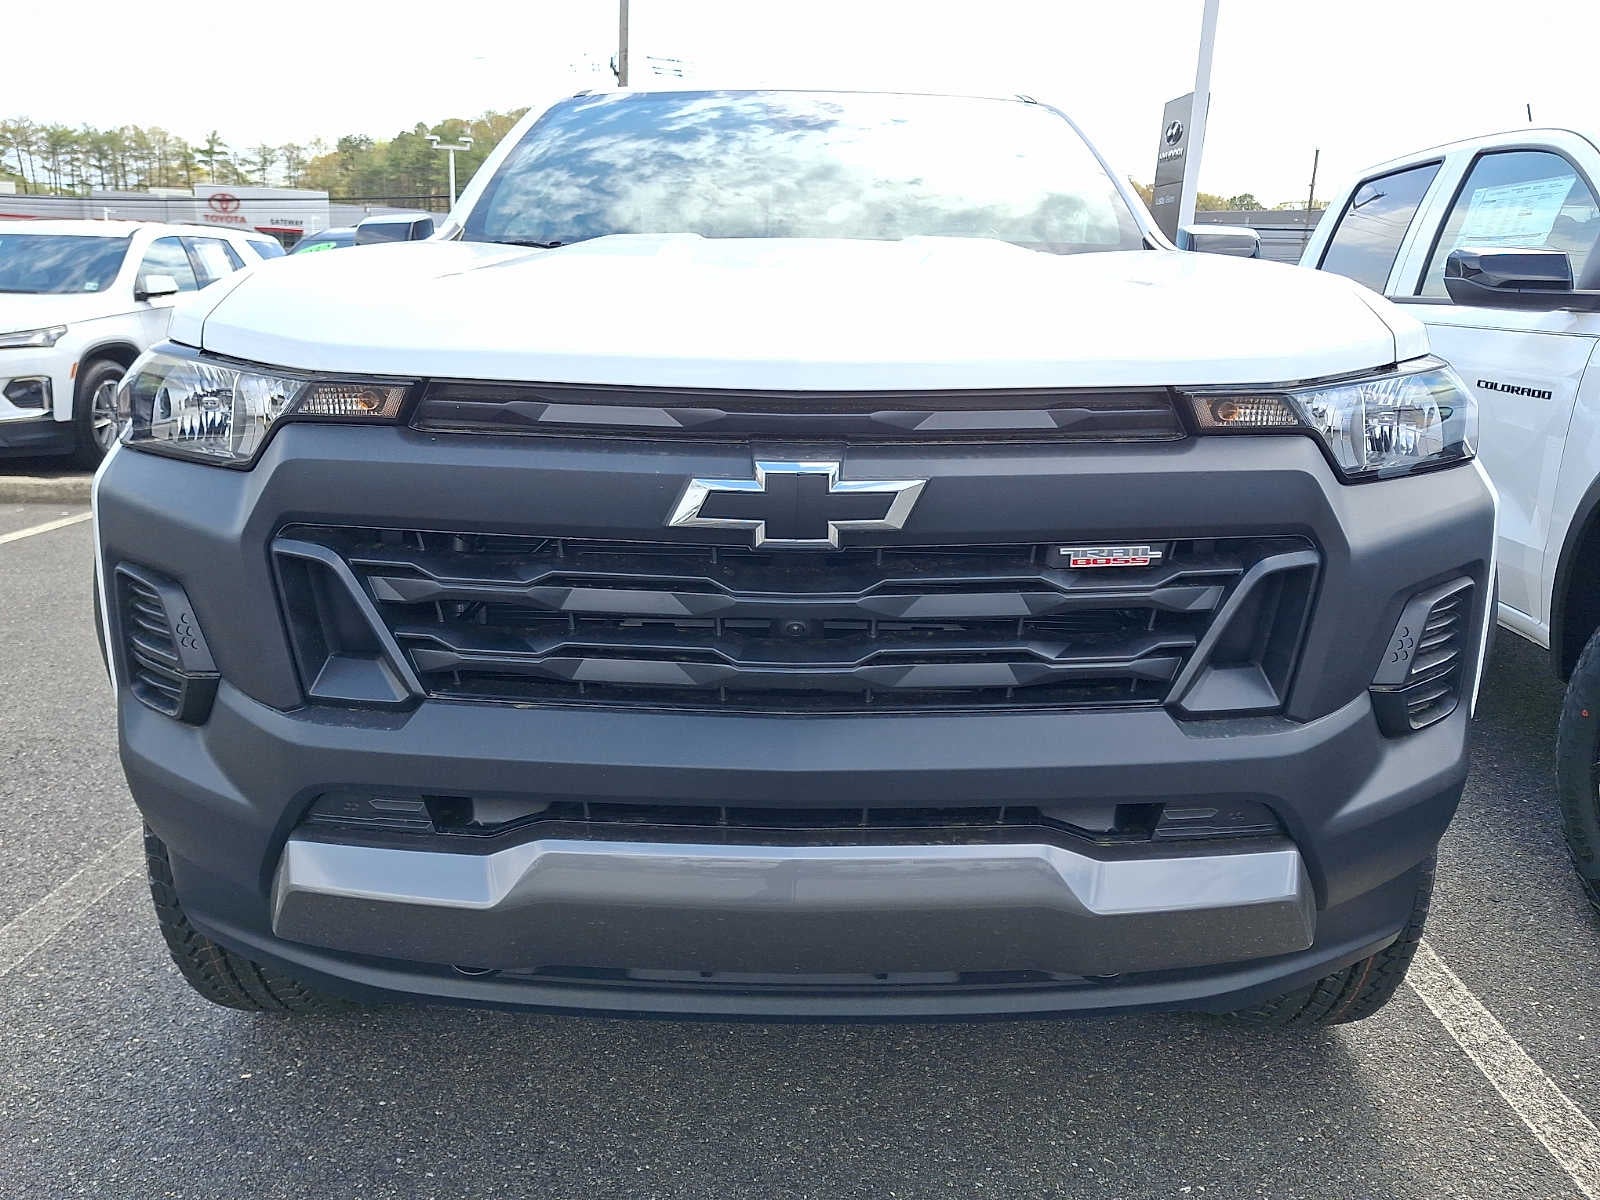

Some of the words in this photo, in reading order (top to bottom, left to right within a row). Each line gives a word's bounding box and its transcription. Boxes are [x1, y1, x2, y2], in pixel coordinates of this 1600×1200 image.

[203, 214, 247, 224] TOYOTA
[1476, 379, 1553, 401] COLORADO
[1060, 546, 1151, 558] TRAIL
[1071, 557, 1149, 567] BOSS
